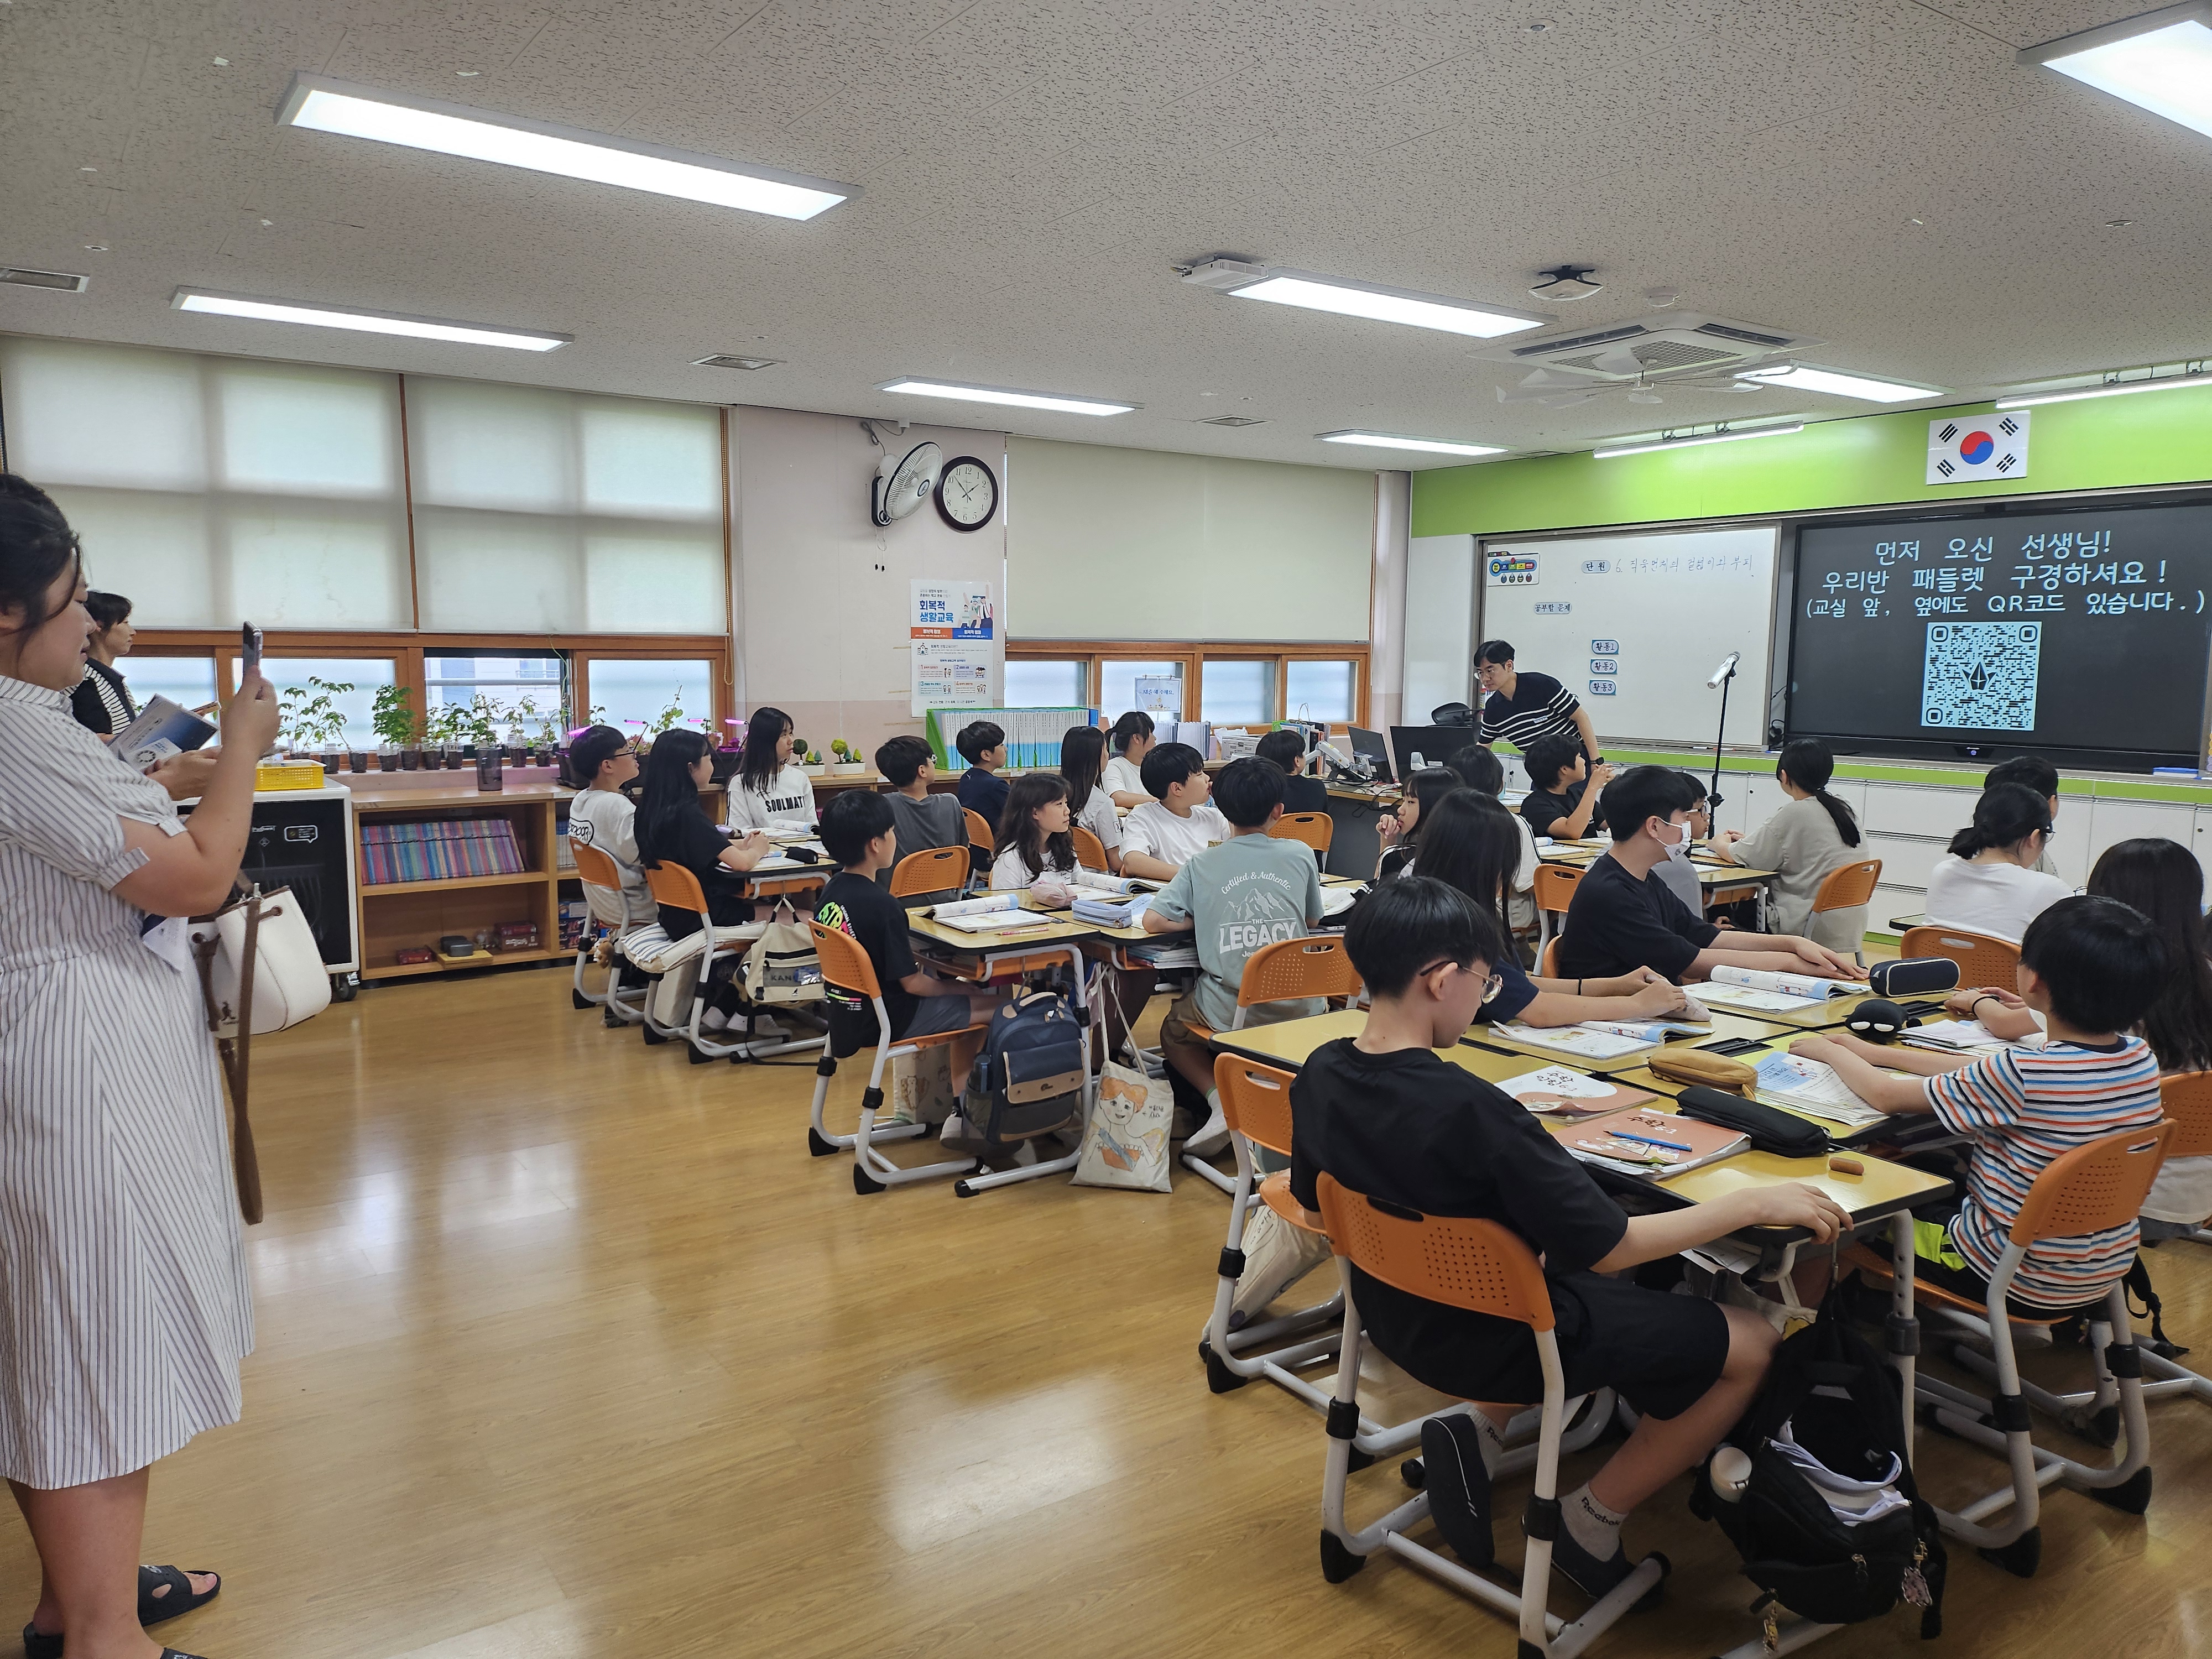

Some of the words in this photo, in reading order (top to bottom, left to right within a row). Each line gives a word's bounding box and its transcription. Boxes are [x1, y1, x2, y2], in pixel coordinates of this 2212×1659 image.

[1875, 540, 1920, 566] 먼저
[1944, 536, 1993, 562] 오신
[2021, 530, 2110, 560] 선생님!
[1616, 559, 1623, 573] 6.
[1730, 555, 1752, 571] 부피
[1822, 570, 1890, 594] 우리반
[1912, 566, 1984, 593] 패들렛
[920, 600, 945, 611] 회복적
[1535, 604, 1554, 612] 공부할
[1557, 603, 1571, 612] 문제
[1806, 598, 1846, 618] (교실
[1863, 597, 1890, 617] 앞,
[1914, 595, 1969, 617] 옆에도
[1987, 594, 2066, 613] QR코드
[920, 612, 953, 623] 생활교육
[1595, 642, 1615, 651] 활동1
[1594, 662, 1614, 671] 활동2
[1593, 683, 1613, 692] 활동3
[765, 796, 805, 812] SOULMAT
[1221, 873, 1249, 894] Certified
[1258, 871, 1291, 890] Authentic
[1219, 922, 1296, 954] LEGACY
[1626, 1117, 1666, 1128] 수학
